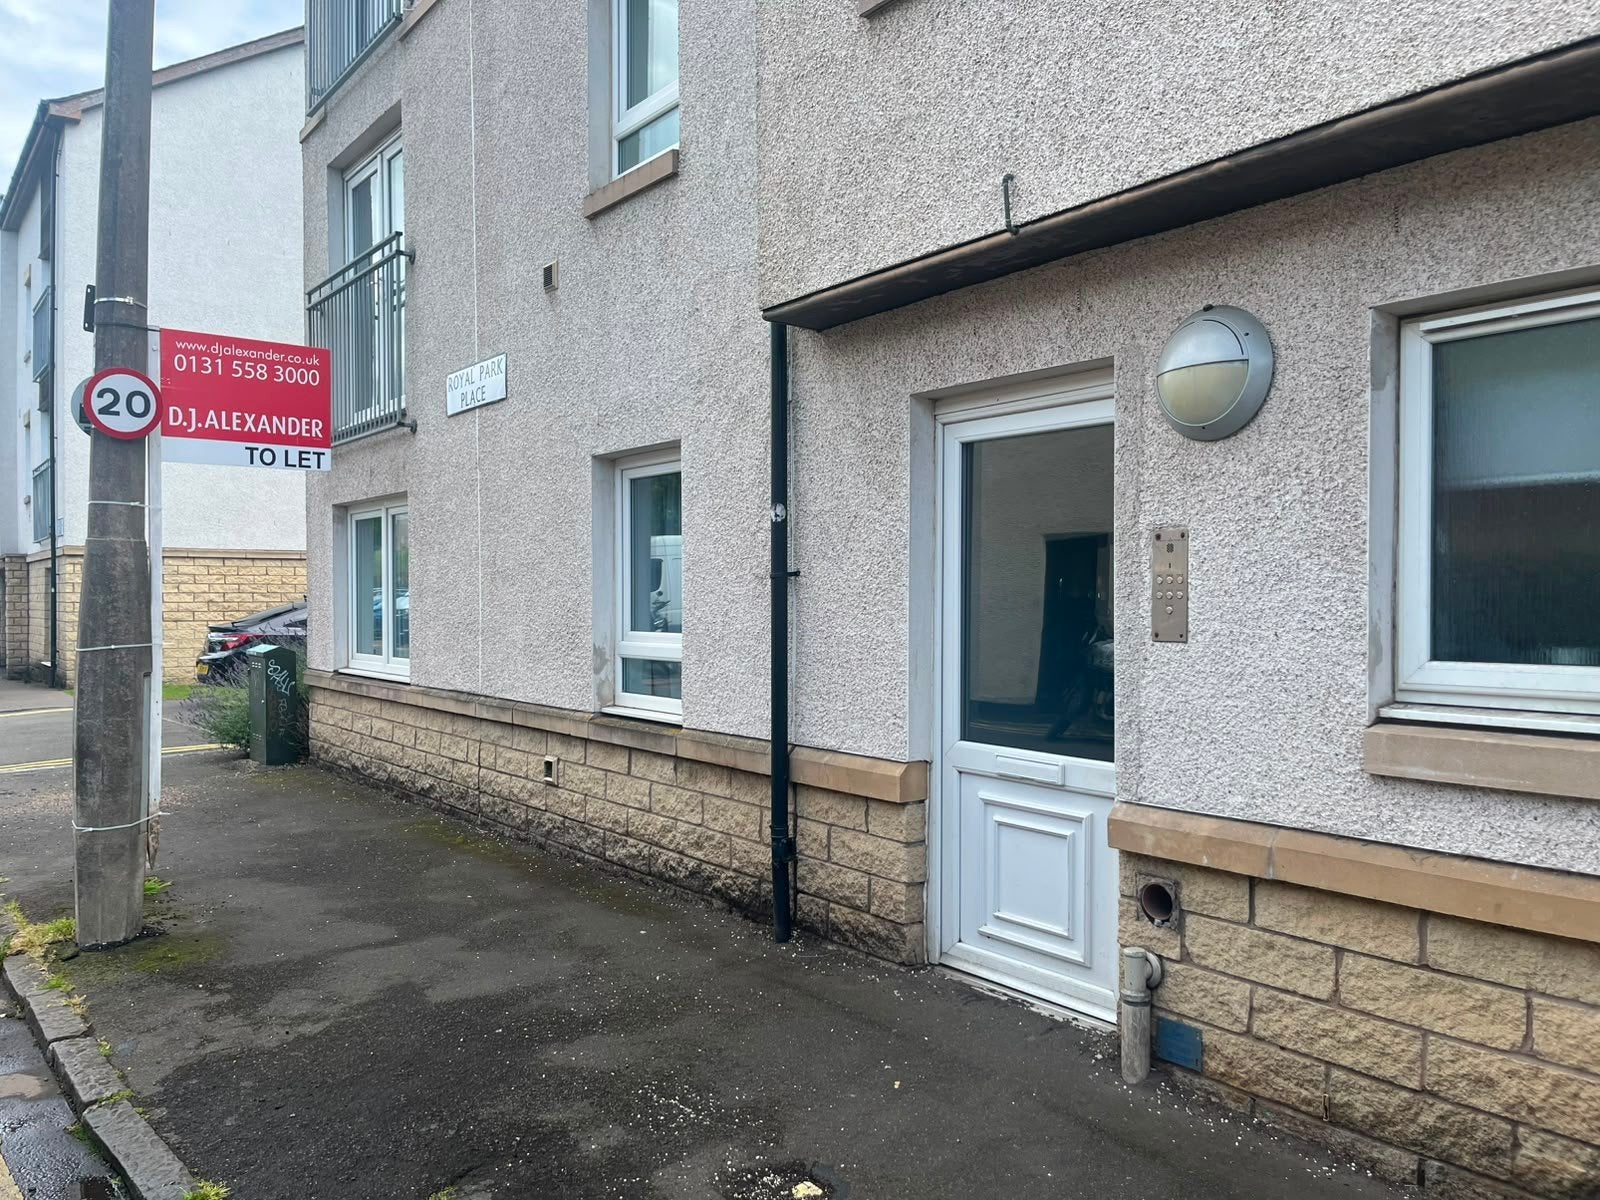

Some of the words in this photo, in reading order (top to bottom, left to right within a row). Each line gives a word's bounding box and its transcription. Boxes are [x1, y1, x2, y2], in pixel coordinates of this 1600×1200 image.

[175, 340, 320, 366] www.djalexander.co.uk
[174, 353, 222, 376] 0131
[231, 360, 268, 381] 558
[273, 365, 320, 386] 3000
[448, 369, 475, 393] ROYAL
[479, 358, 503, 382] PARK
[96, 387, 151, 419] 20
[460, 385, 486, 409] PLACE
[245, 446, 277, 467] TO
[284, 449, 325, 469] LET
